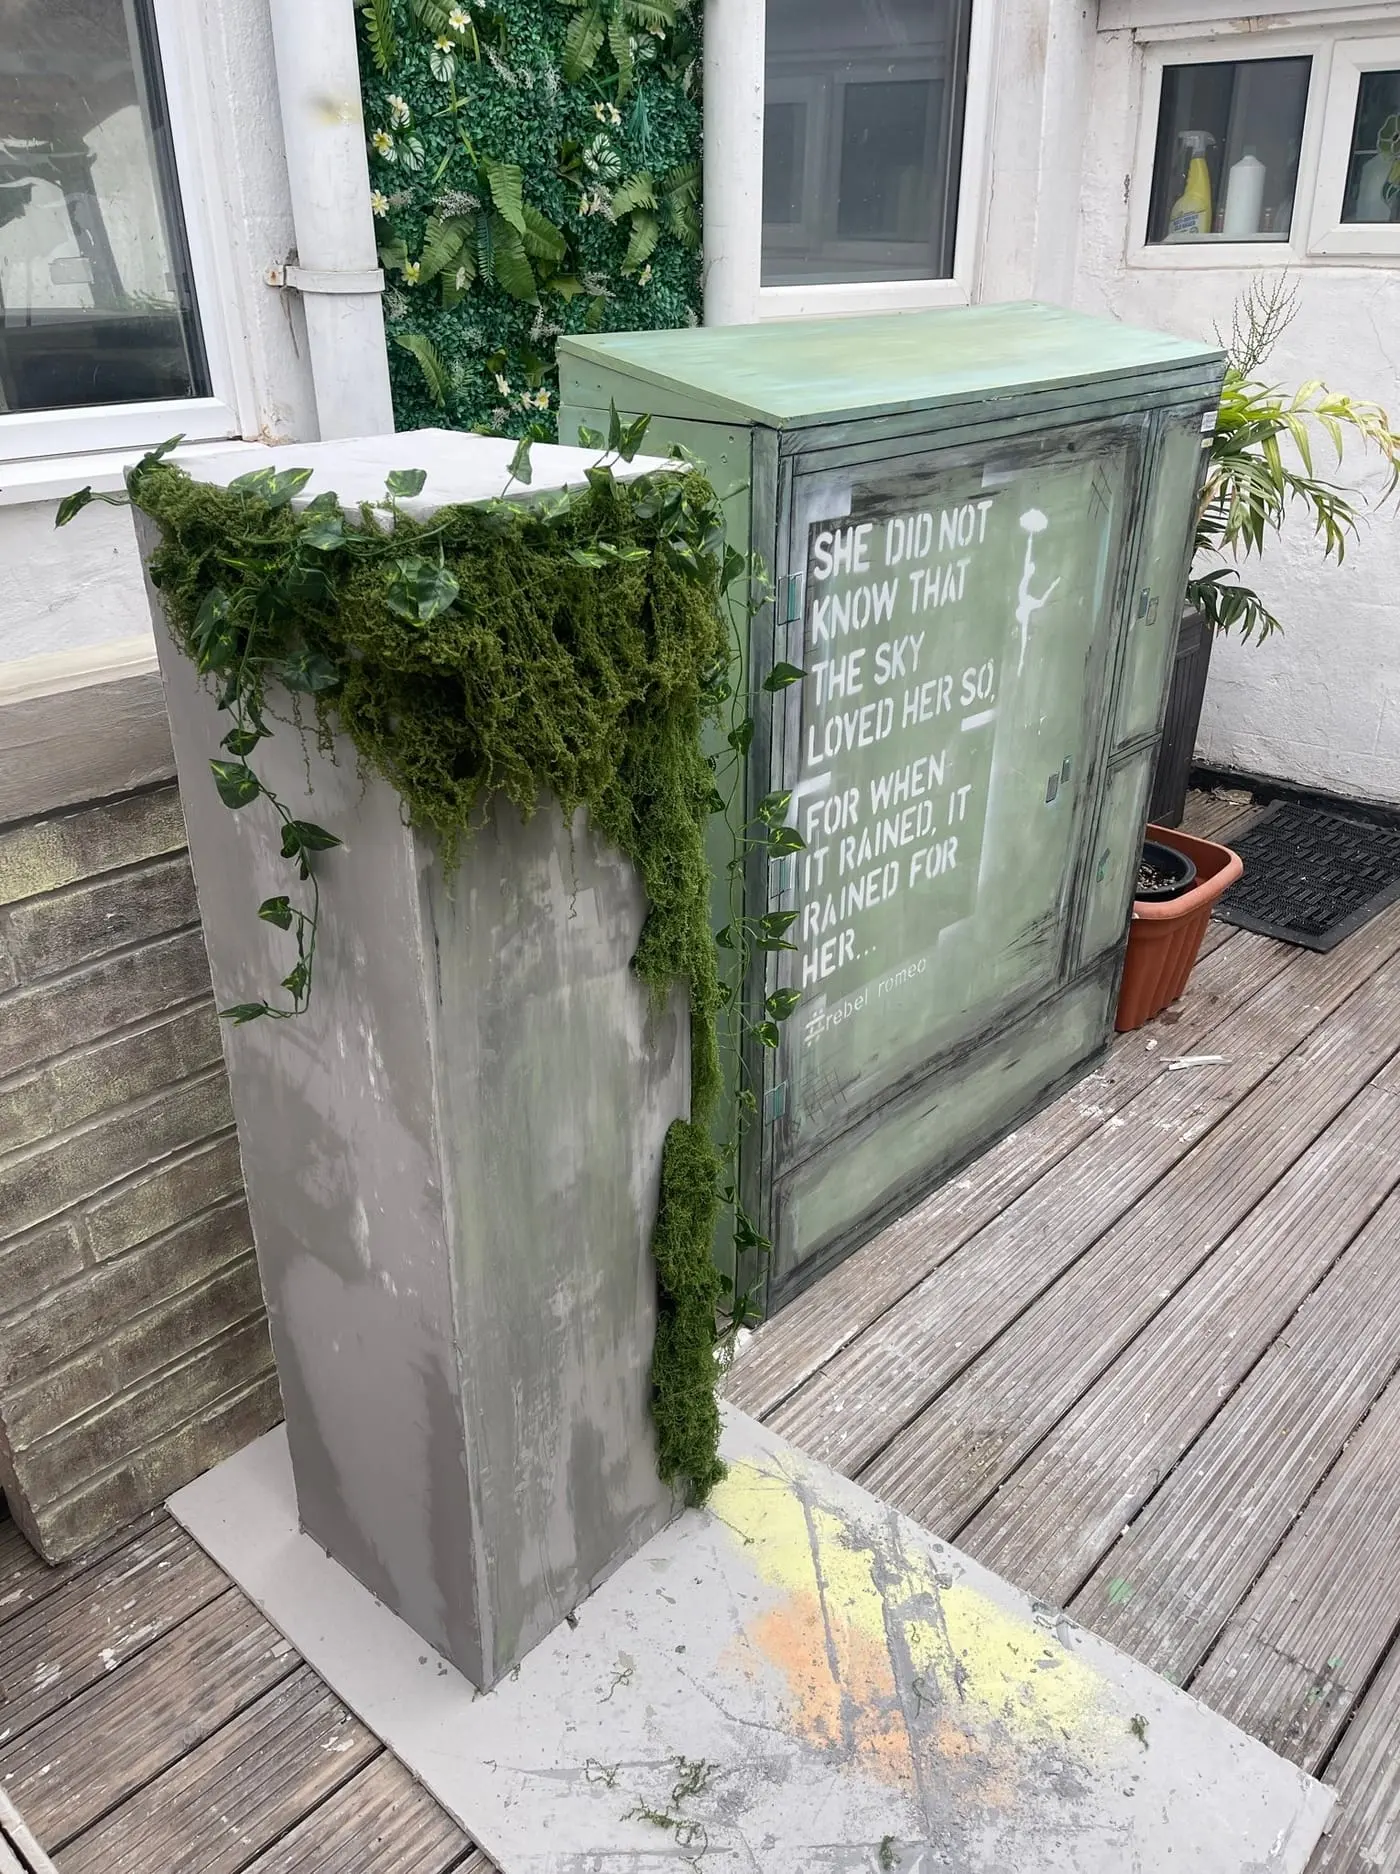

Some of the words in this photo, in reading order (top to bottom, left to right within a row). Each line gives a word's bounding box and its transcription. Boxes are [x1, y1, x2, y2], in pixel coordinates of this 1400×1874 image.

[814, 523, 873, 580] SHE
[885, 513, 933, 566] DID
[938, 500, 993, 552] NOT
[812, 577, 899, 645] KNOW
[909, 557, 972, 614] THAT
[807, 697, 894, 767] LOVED
[902, 675, 953, 728] HER
[960, 659, 996, 706] SO,
[811, 647, 866, 706] THE
[874, 631, 925, 685] SKY
[805, 846, 829, 892] IT
[839, 802, 937, 877] RAINED,
[948, 784, 972, 825] IT
[806, 787, 860, 844] FOR
[870, 749, 947, 815] WHEN
[803, 860, 899, 942] RAINED
[909, 836, 958, 889] FOR
[802, 929, 876, 989] HER...
[804, 987, 868, 1048] #rebel
[878, 958, 926, 997] romeo
